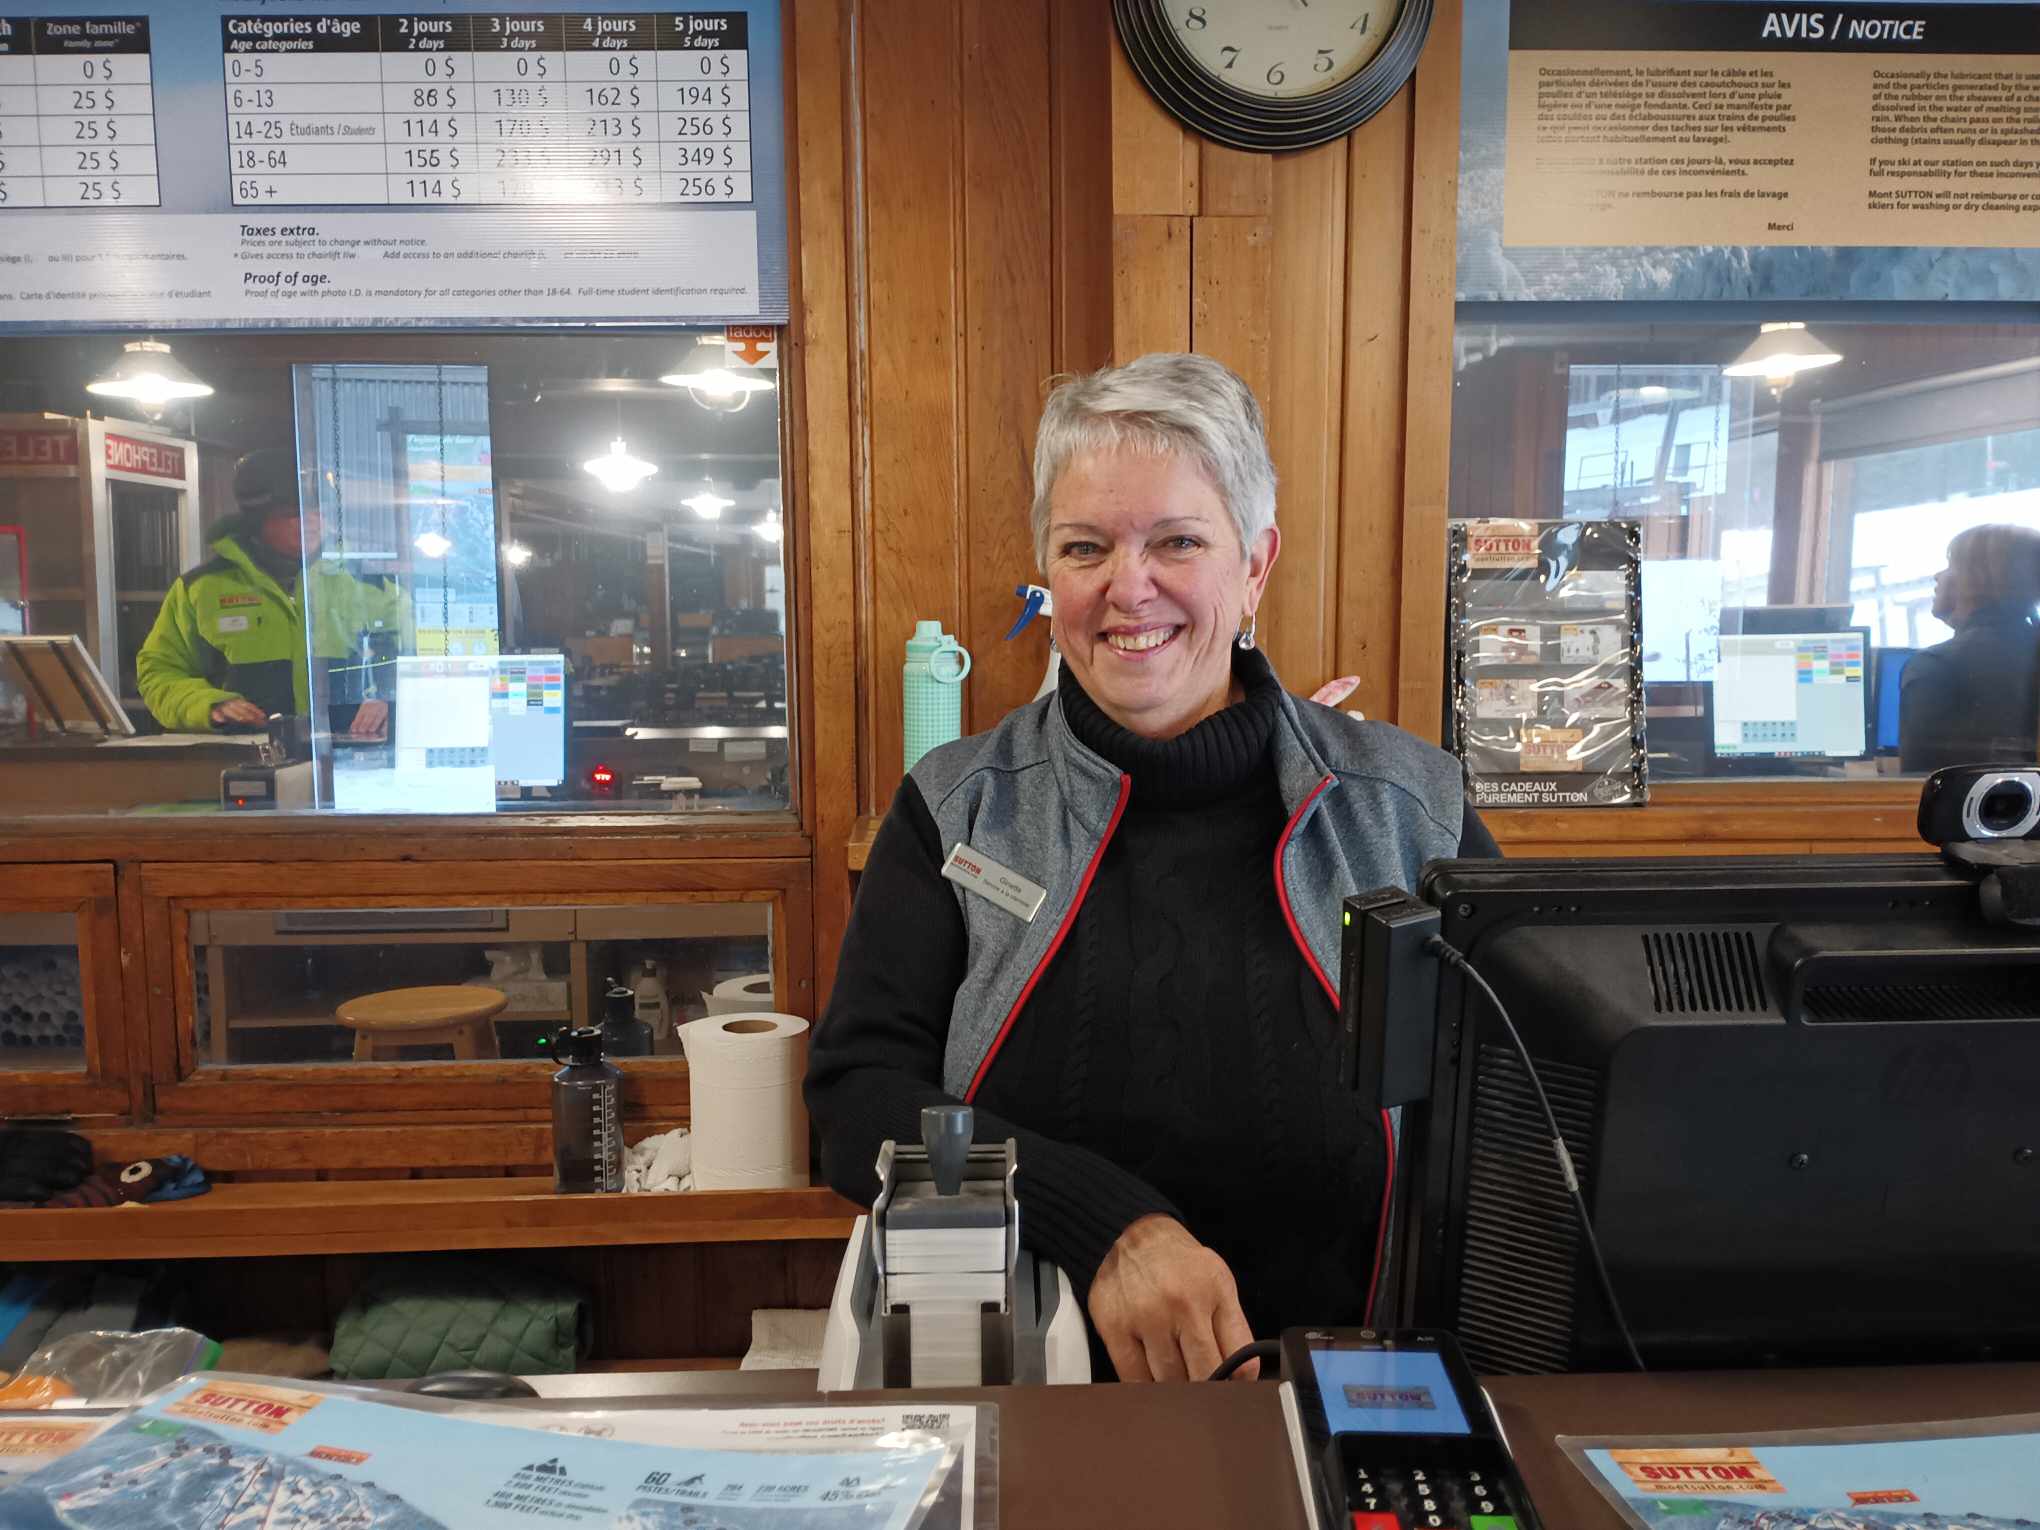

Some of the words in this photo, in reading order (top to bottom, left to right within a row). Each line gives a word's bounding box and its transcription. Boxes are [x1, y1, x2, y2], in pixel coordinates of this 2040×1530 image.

[46, 22, 81, 35] Zone
[228, 18, 312, 38] Catégories
[316, 18, 361, 38] d'âge
[399, 18, 408, 33] 2
[413, 17, 453, 36] jours
[491, 18, 500, 32] 3
[505, 17, 545, 36] jours
[583, 18, 593, 32] 4
[597, 16, 636, 35] jours
[675, 16, 684, 31] 5
[688, 15, 728, 35] jours
[1185, 7, 1207, 31] 8
[1349, 12, 1369, 36] 4
[1761, 12, 1825, 39] AVIS
[1849, 20, 1926, 40] NOTICE
[230, 39, 252, 52] Age
[256, 39, 314, 51] categories
[408, 38, 415, 49] 2
[419, 37, 445, 51] days
[501, 38, 508, 48] 3
[511, 37, 537, 51] days
[592, 37, 599, 48] 4
[603, 36, 628, 50] days
[684, 36, 691, 48] 5
[694, 36, 720, 49] days
[425, 58, 436, 77] 0
[445, 56, 455, 78] $
[517, 57, 528, 76] 0
[537, 55, 547, 78] $
[609, 57, 620, 76] 0
[629, 55, 639, 78] $
[700, 56, 711, 75] 0
[720, 54, 730, 77] $
[1220, 46, 1242, 69] 7
[1313, 48, 1335, 73] 5
[83, 60, 94, 79] 0
[103, 58, 113, 80] $
[1266, 61, 1285, 86] 6
[73, 90, 96, 109] 25
[104, 88, 115, 110] $
[446, 85, 457, 109] $
[585, 87, 621, 106] 162
[630, 85, 640, 108] $
[677, 86, 712, 105] 194
[721, 83, 731, 107] $
[75, 120, 98, 139] 25
[107, 118, 117, 140] $
[289, 121, 334, 137] Étudiants
[403, 119, 439, 137] 114
[448, 116, 458, 139] $
[586, 118, 622, 137] 213
[631, 116, 641, 138] $
[677, 116, 713, 136] 256
[722, 114, 732, 137] $
[77, 151, 100, 170] 25
[109, 149, 119, 171] $
[449, 146, 460, 169] $
[632, 146, 642, 168] $
[678, 147, 714, 166] 349
[723, 145, 733, 168] $
[79, 181, 102, 200] 25
[111, 179, 121, 202] $
[239, 180, 259, 199] 65
[406, 179, 442, 198] 114
[451, 177, 461, 200] $
[679, 177, 716, 196] 256
[724, 175, 734, 198] $
[1868, 190, 1893, 199] Mont
[1894, 190, 1933, 199] SUTTON
[1935, 190, 1952, 199] will
[1953, 191, 1969, 200] not
[1970, 191, 2017, 200] reimburse
[2018, 193, 2029, 201] or
[1868, 201, 1894, 209] skiers
[1896, 200, 1910, 210] for
[1911, 201, 1950, 212] washing
[1963, 201, 1979, 212] dry
[1981, 201, 2021, 213] cleaning
[240, 224, 276, 237] Taxes
[280, 225, 320, 237] extra.
[1767, 221, 1794, 231] Merci
[240, 238, 267, 247] Prices
[268, 239, 283, 247] are
[285, 238, 316, 248] subject
[318, 239, 327, 247] to
[329, 238, 361, 248] change
[363, 238, 398, 247] without
[243, 271, 281, 286] Proof
[284, 271, 299, 286] of
[302, 273, 332, 286] age.
[245, 288, 268, 299] Proof
[270, 288, 280, 298] of
[282, 289, 297, 298] age
[300, 288, 320, 297] with
[321, 288, 347, 299] photo
[365, 288, 373, 297] is
[374, 288, 422, 298] mandatory
[424, 288, 437, 298] for
[439, 288, 450, 297] all
[452, 288, 496, 298] categories
[498, 287, 522, 297] other
[524, 287, 544, 297] than
[578, 287, 616, 297] Full-time
[617, 287, 650, 297] student
[651, 286, 707, 298] identification
[709, 286, 748, 297] required.
[1475, 781, 1498, 792] DES
[1501, 781, 1557, 792] CADEAUX
[1476, 792, 1540, 803] PUREMENT
[1542, 791, 1588, 803] SUTTON
[952, 854, 983, 875] SUTTON
[196, 1392, 292, 1419] SUTTON
[1358, 1468, 1368, 1479] 1
[1413, 1470, 1426, 1481] 2
[1639, 1465, 1755, 1480] SUTTON
[1361, 1483, 1374, 1494] 4
[1474, 1485, 1487, 1497] 6
[1365, 1498, 1377, 1510] 7
[1424, 1499, 1437, 1511] 8
[1480, 1501, 1494, 1513] 9
[1428, 1514, 1441, 1527] 0
